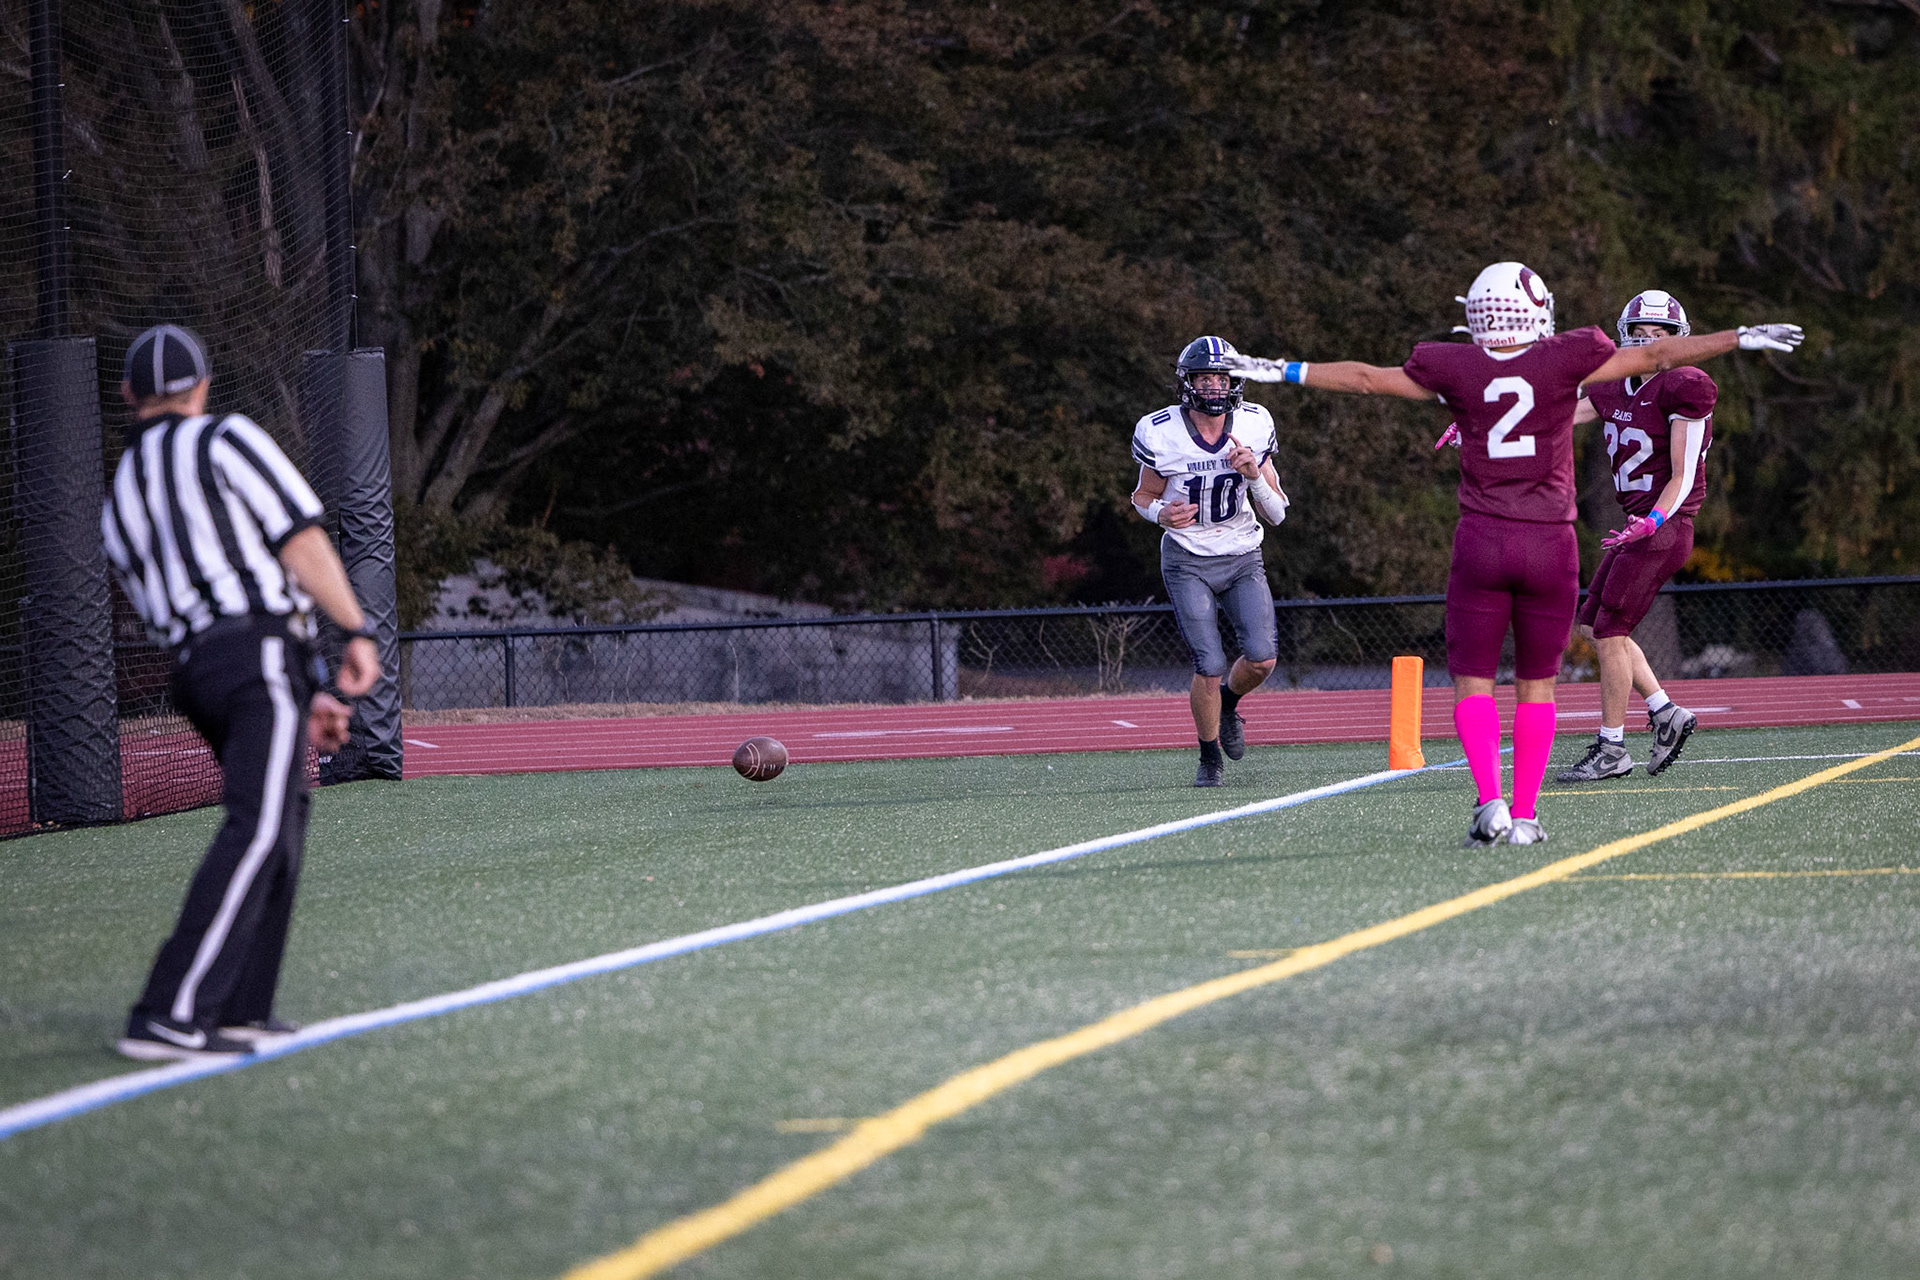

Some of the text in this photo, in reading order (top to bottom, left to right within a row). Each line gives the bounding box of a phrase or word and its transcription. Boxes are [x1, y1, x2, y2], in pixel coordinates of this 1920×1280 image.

[1485, 314, 1497, 331] 2
[1477, 336, 1516, 346] Riddell
[1150, 409, 1171, 426] 10
[1483, 375, 1536, 459] 2
[1612, 408, 1633, 421] RAMS
[1603, 420, 1655, 492] 22
[1187, 459, 1217, 471] VALLEY
[1182, 472, 1244, 527] 10
